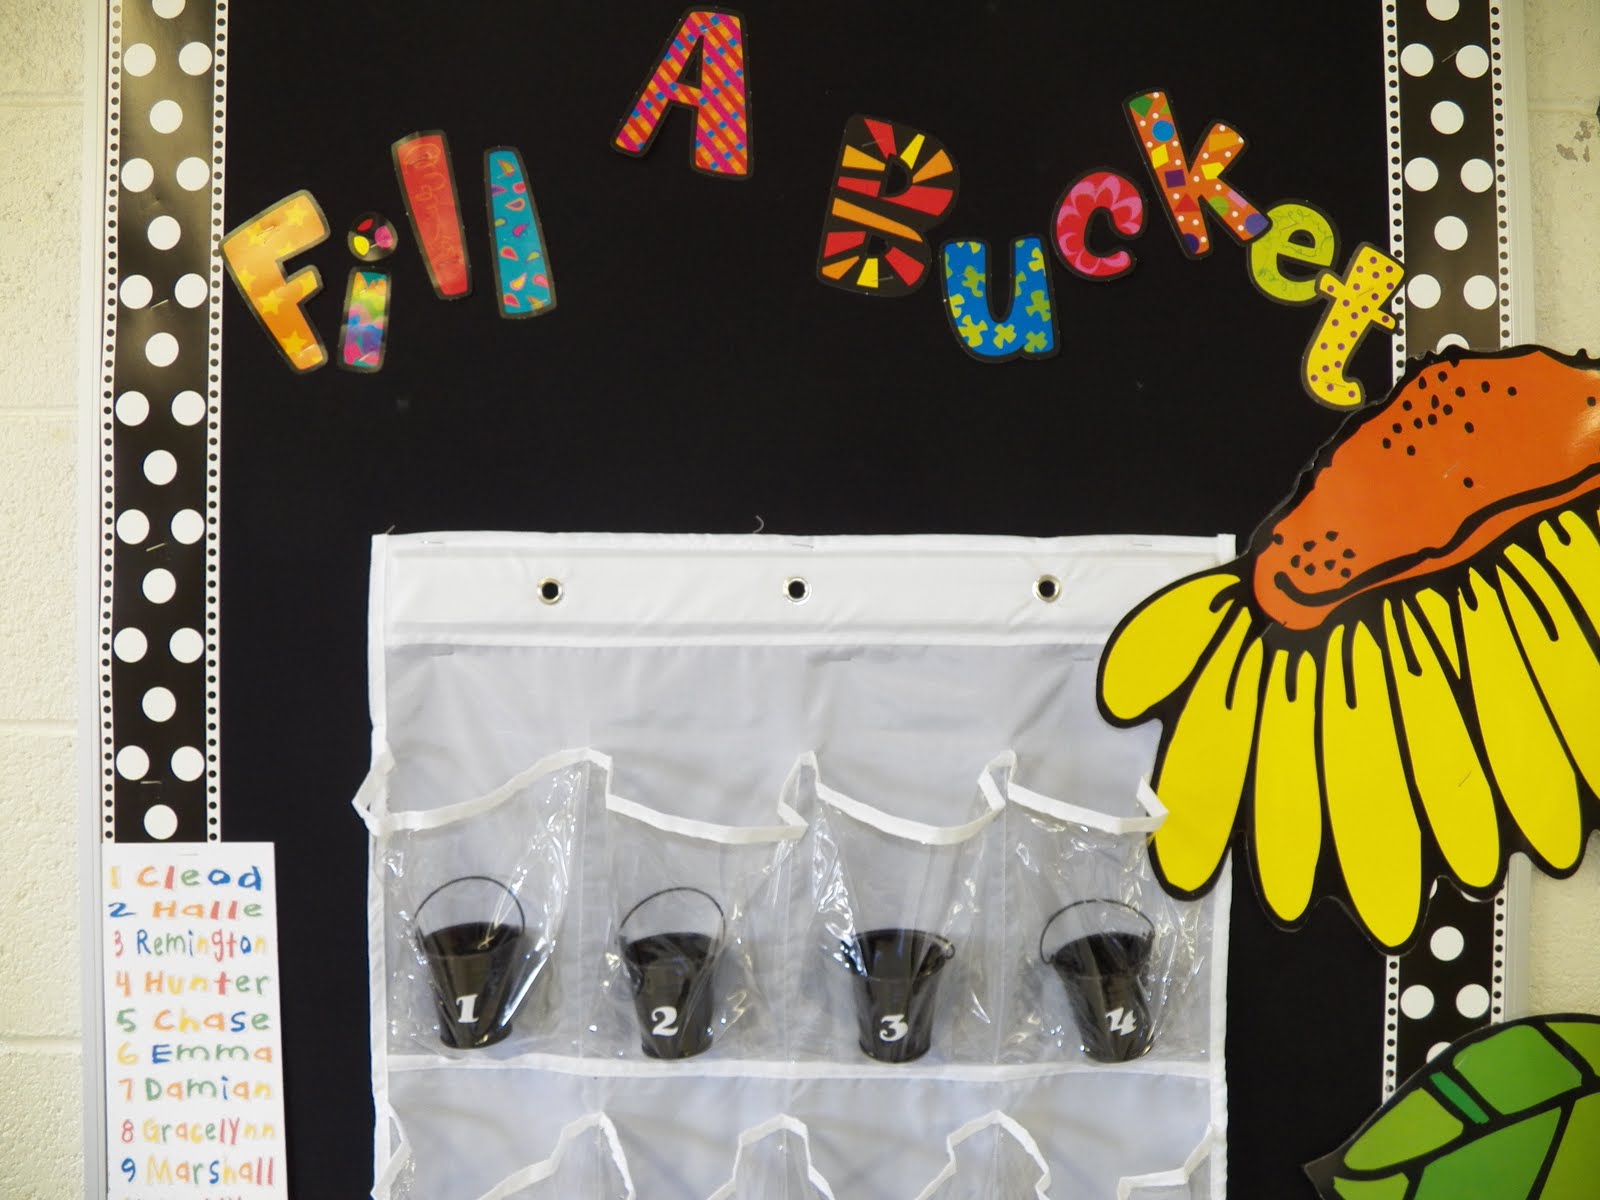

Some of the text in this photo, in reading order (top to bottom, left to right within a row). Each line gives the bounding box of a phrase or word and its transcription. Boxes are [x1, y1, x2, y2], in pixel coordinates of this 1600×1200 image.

[222, 8, 1406, 411] Fill A Bucket
[110, 866, 120, 889] 1
[108, 900, 264, 920] 2 Halle
[114, 929, 267, 963] 3 Remington
[115, 971, 269, 997] 4 Hunter
[116, 1008, 270, 1033] 5 Chase
[456, 995, 480, 1024] 1
[650, 1006, 680, 1037] 2
[1106, 1008, 1137, 1037] 4
[880, 1014, 909, 1042] 3
[116, 1042, 272, 1066] 6 Emma
[118, 1076, 272, 1103] 7 Damian
[120, 1119, 135, 1145] 8
[120, 1156, 275, 1186] 9 Marshall
